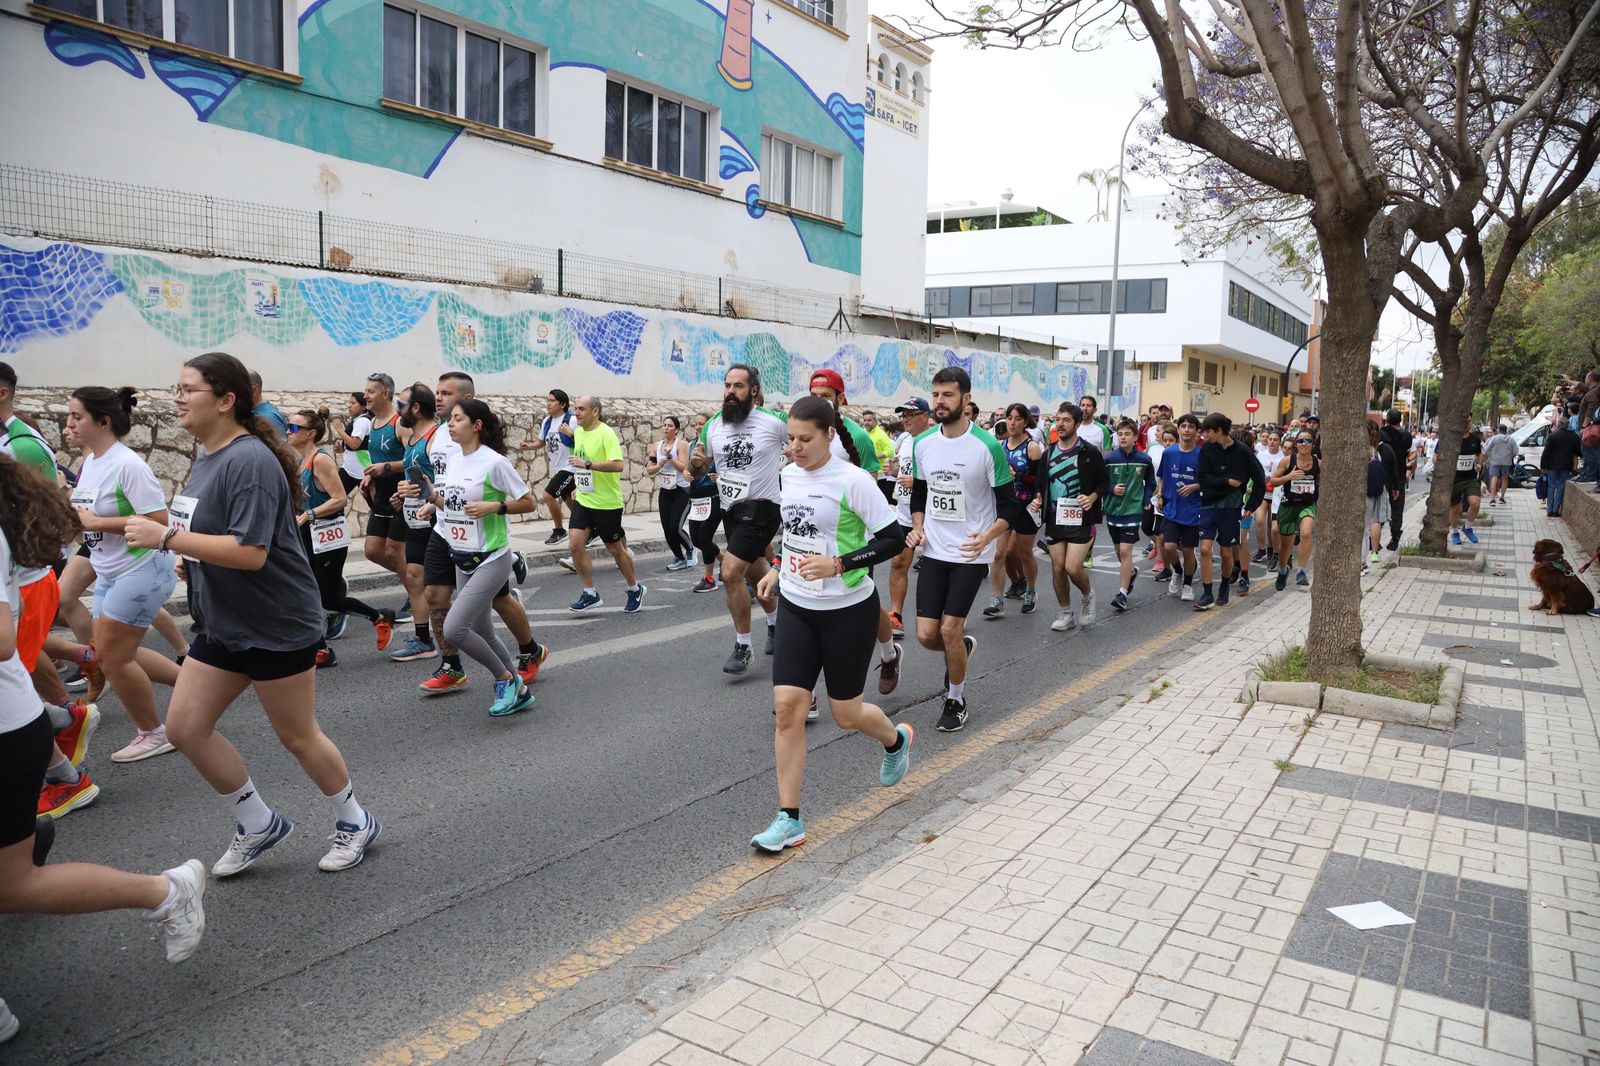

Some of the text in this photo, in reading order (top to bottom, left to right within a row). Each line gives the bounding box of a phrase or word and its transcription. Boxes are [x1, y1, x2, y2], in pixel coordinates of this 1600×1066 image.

[876, 108, 895, 124] SAFA
[902, 120, 918, 134] ICET
[663, 476, 670, 484] 75
[721, 484, 742, 499] 887
[1296, 486, 1311, 494] 311
[933, 496, 957, 510] 661
[1062, 509, 1082, 518] 386
[318, 527, 344, 544] 280
[452, 526, 467, 540] 92
